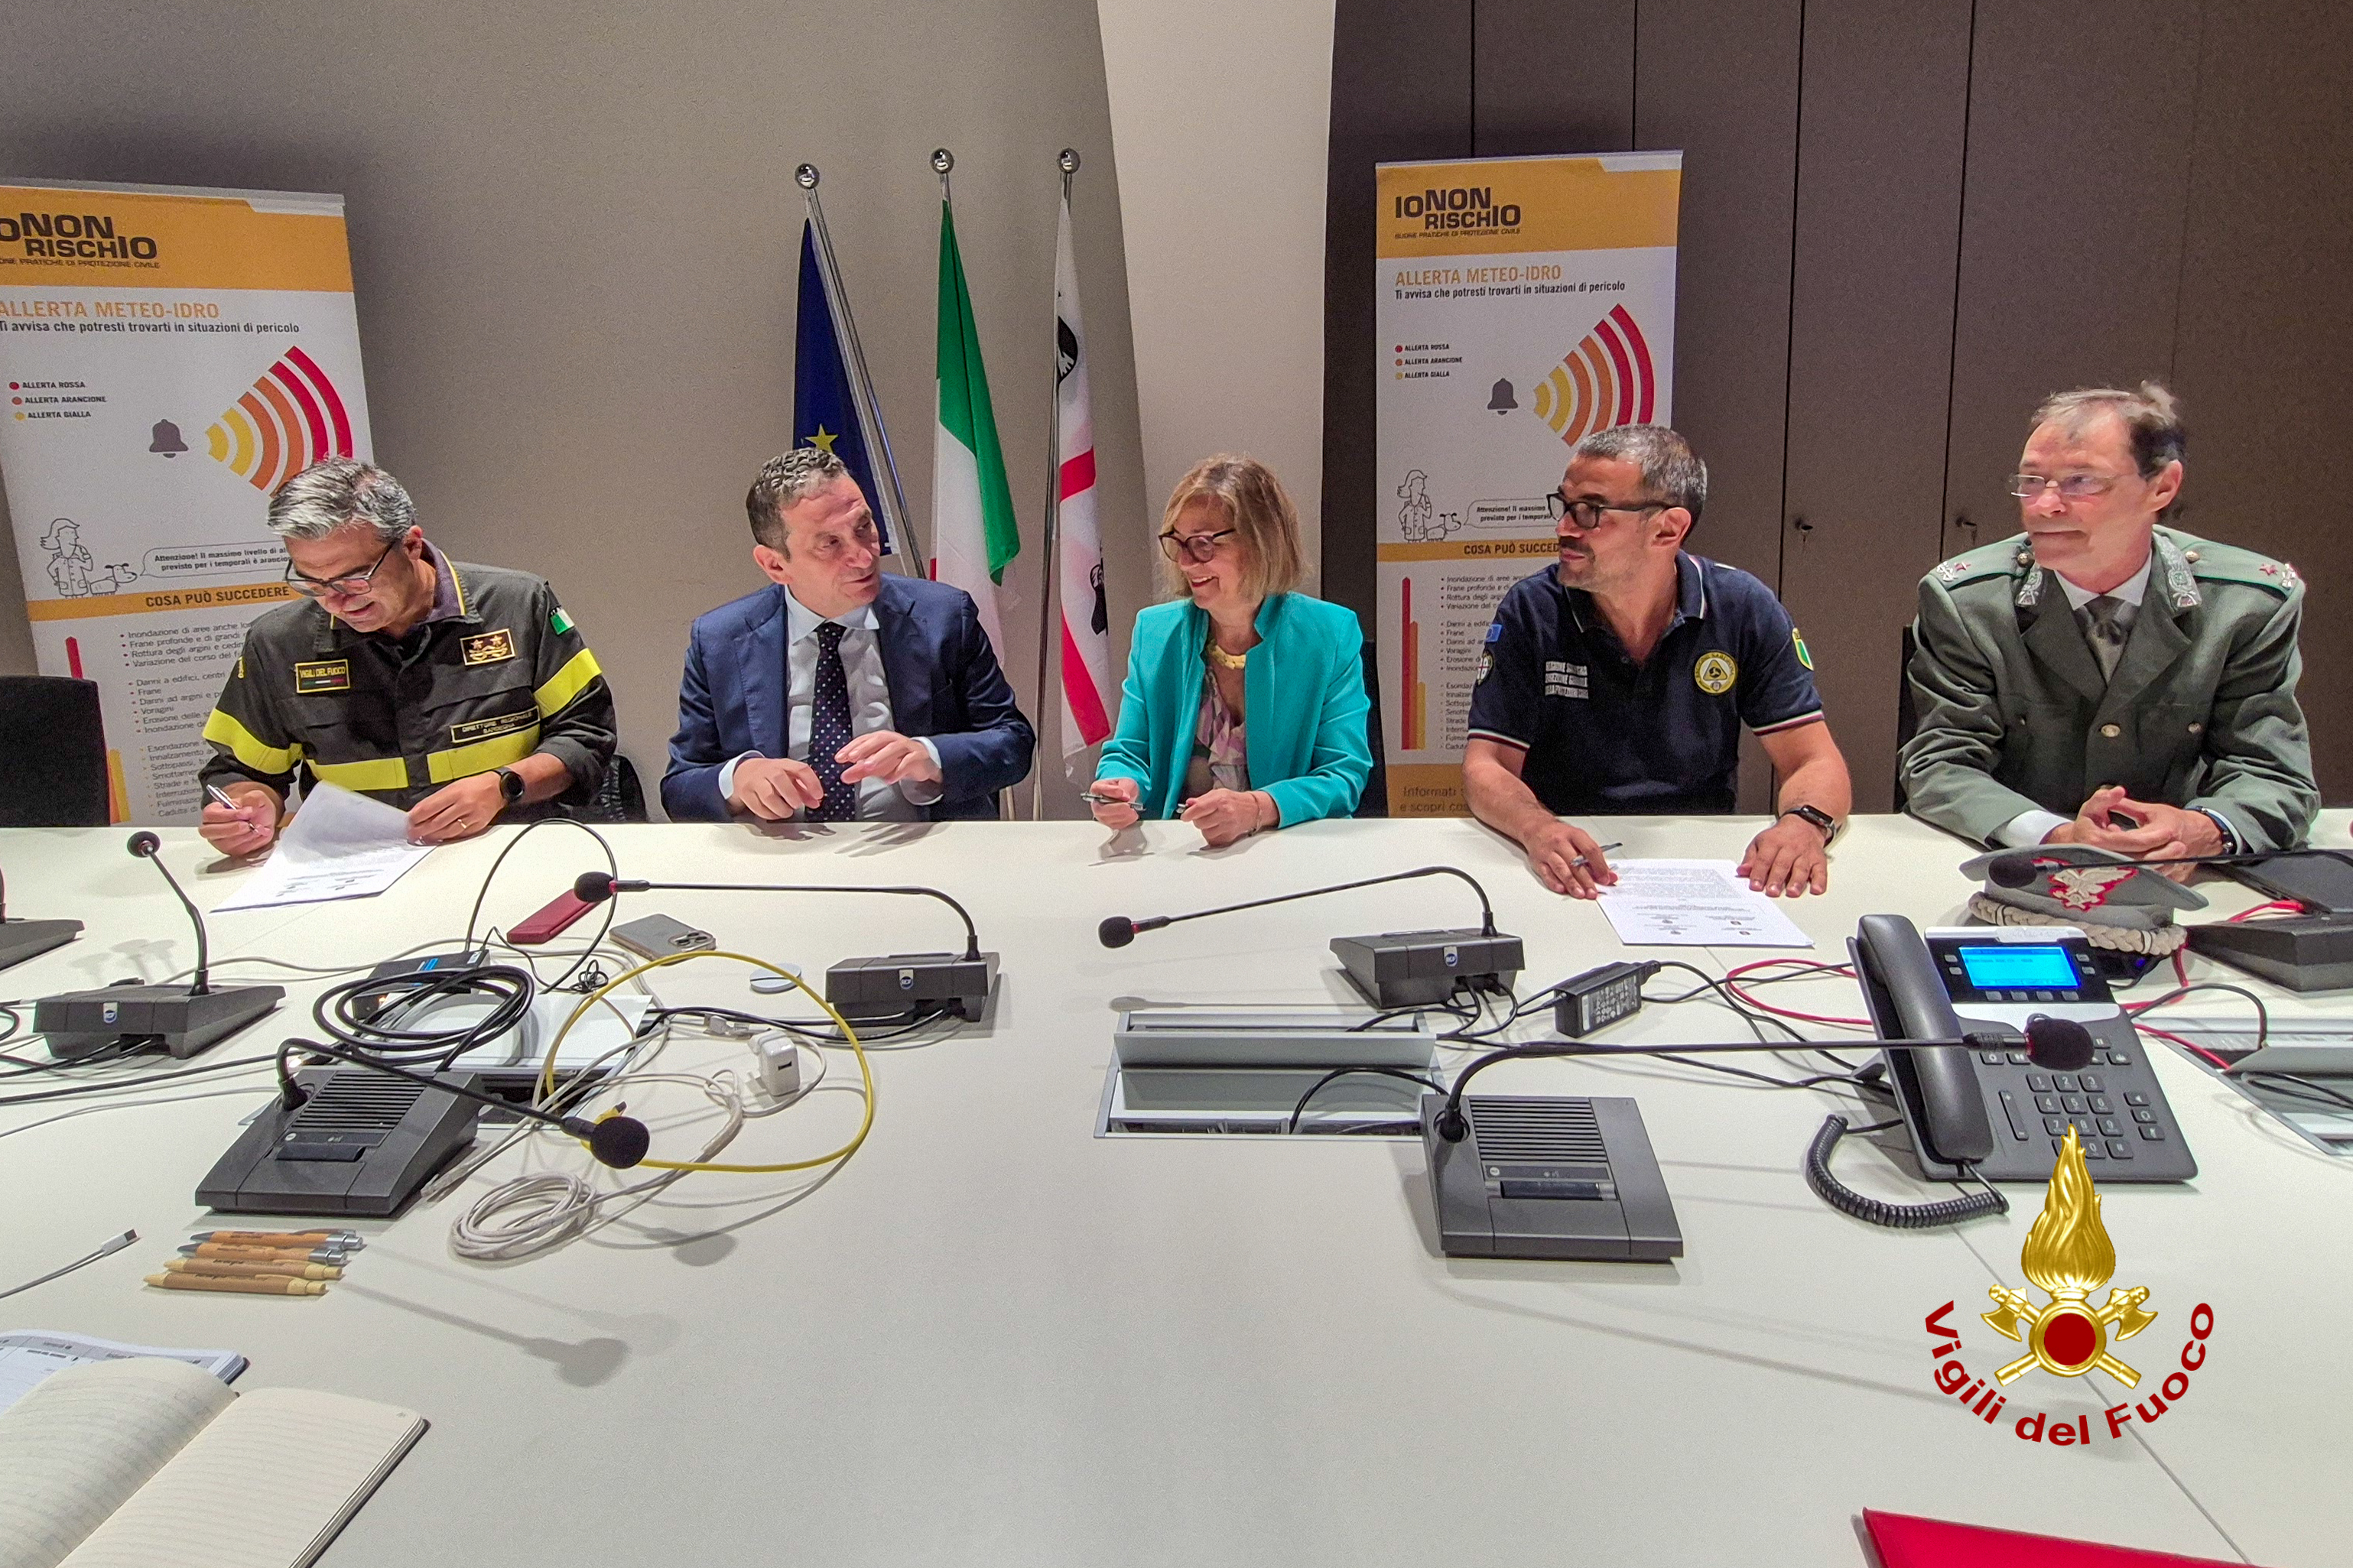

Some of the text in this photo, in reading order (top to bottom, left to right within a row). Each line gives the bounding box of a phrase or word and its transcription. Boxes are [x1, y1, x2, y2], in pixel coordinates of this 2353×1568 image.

[1396, 187, 1490, 219] IO NON
[1425, 204, 1521, 230] RISCHIO
[21, 213, 115, 239] NON
[25, 236, 158, 259] RISCHIO
[1395, 265, 1562, 287] ALLERTA METEO-IDRO
[1395, 281, 1625, 300] Ti avvisa che potresti trovarti in situazioni di pericolo
[0, 301, 219, 319] ALLERTA METEO-IDRO
[0, 321, 299, 333] Ti avvisa che potresti trovarti in situazioni di pericolo
[155, 553, 198, 562] Attenzione!
[208, 550, 242, 558] massimo
[244, 547, 268, 556] livello
[1464, 544, 1491, 555] COSA
[1495, 541, 1515, 554] PUÒ
[214, 557, 251, 567] temporali
[145, 586, 290, 608] COSA PUÒ SUCCEDERE
[128, 628, 179, 638] Inondazione
[213, 622, 238, 631] anche
[157, 636, 193, 647] profonde
[215, 632, 240, 642] grandi
[132, 648, 164, 658] Rottura
[132, 657, 175, 667] Variazione
[1403, 786, 1457, 798] Informati
[1409, 803, 1445, 813] scopri
[2088, 1076, 2095, 1085] 3
[2046, 1098, 2052, 1106] 4
